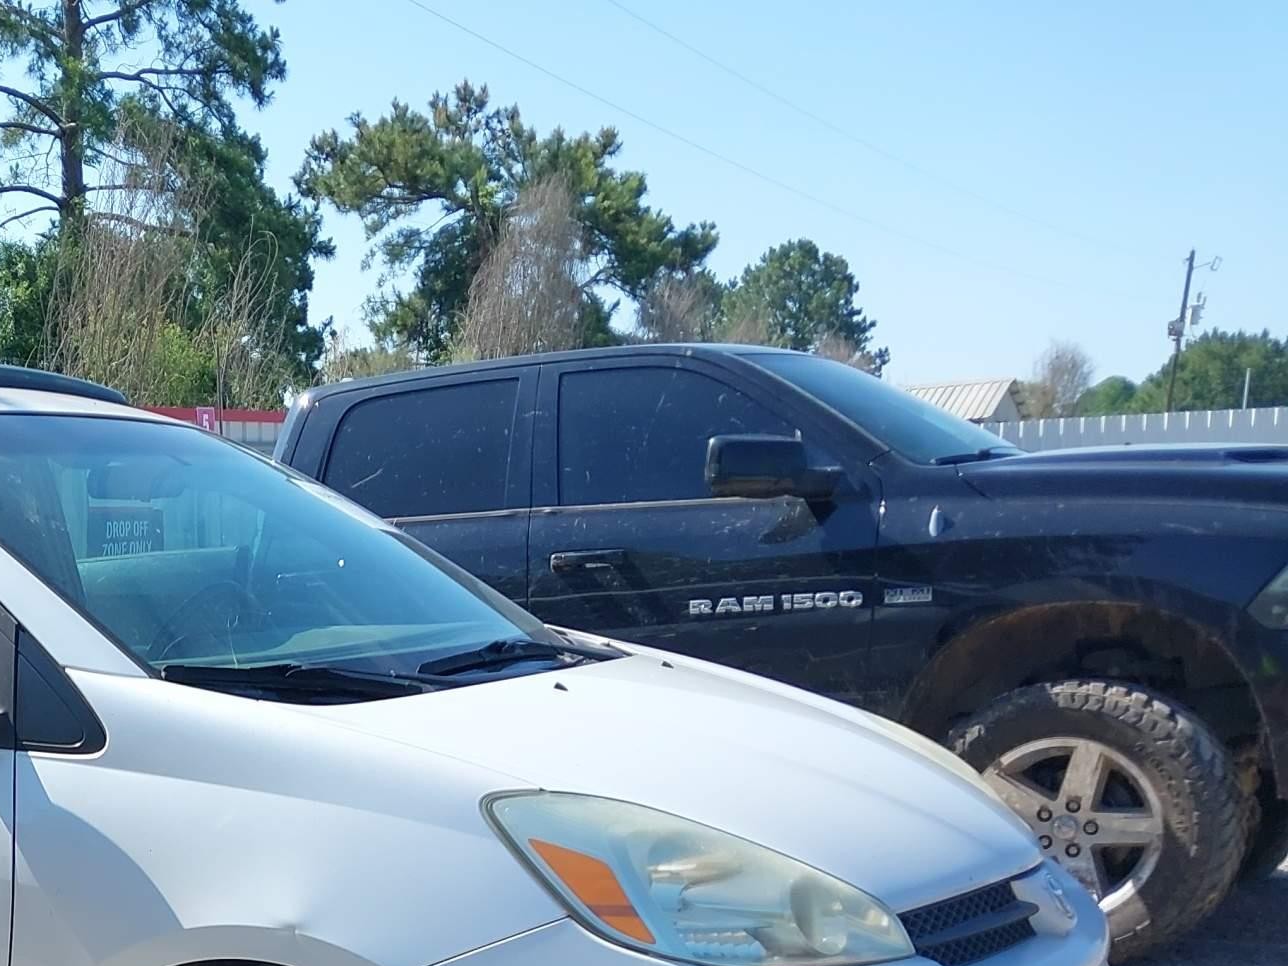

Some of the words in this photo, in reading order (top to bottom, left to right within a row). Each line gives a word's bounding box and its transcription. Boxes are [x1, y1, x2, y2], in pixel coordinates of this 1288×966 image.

[106, 521, 130, 538] DROP
[133, 520, 149, 537] OFF
[102, 543, 126, 557] ZONE
[129, 541, 152, 555] ONLY
[689, 595, 774, 614] RAM
[781, 591, 863, 610] 1500
